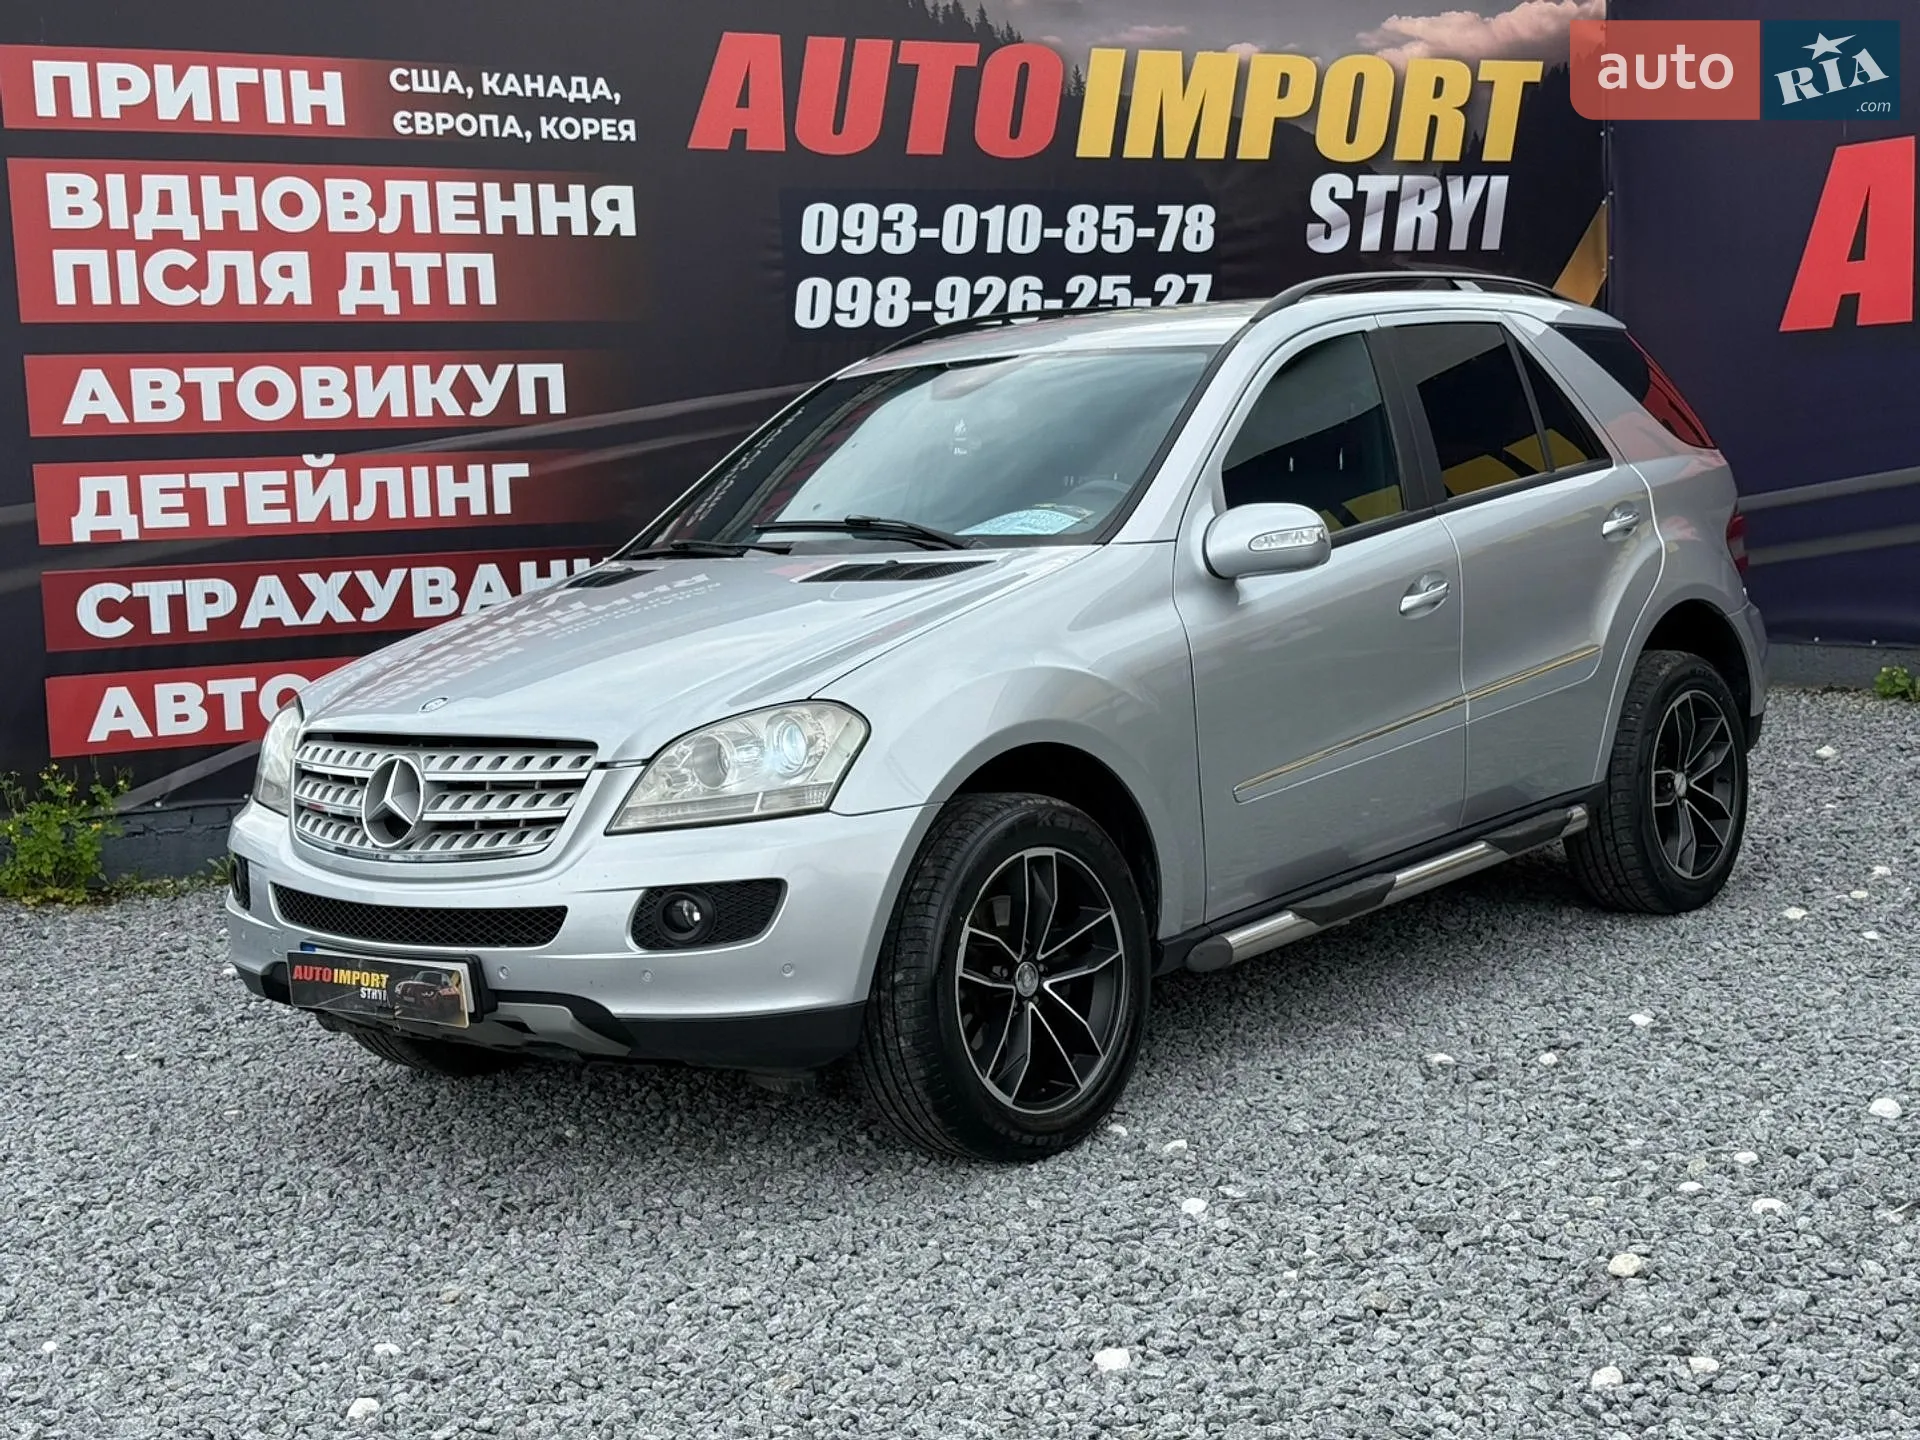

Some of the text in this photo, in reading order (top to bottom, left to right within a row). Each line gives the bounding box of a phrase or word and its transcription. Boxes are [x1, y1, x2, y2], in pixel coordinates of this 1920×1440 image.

[32, 59, 346, 126] ПРИГІН
[389, 67, 621, 105] США, КАНАДА,
[688, 32, 1543, 163] AUTO IMPORT
[393, 110, 636, 143] ЄВРОПА, КОРЕЯ
[45, 172, 637, 240] ВІДНОВЛЕННЯ
[801, 202, 1216, 255] 093-010-85-78
[1306, 172, 1510, 254] STRYI
[52, 248, 497, 315] ПІСЛЯ ДТП
[794, 273, 1213, 329] 098-926-25-27
[62, 363, 567, 425] АВТОВИКУП
[70, 453, 530, 543] ДЕТЕЙЛІНГ
